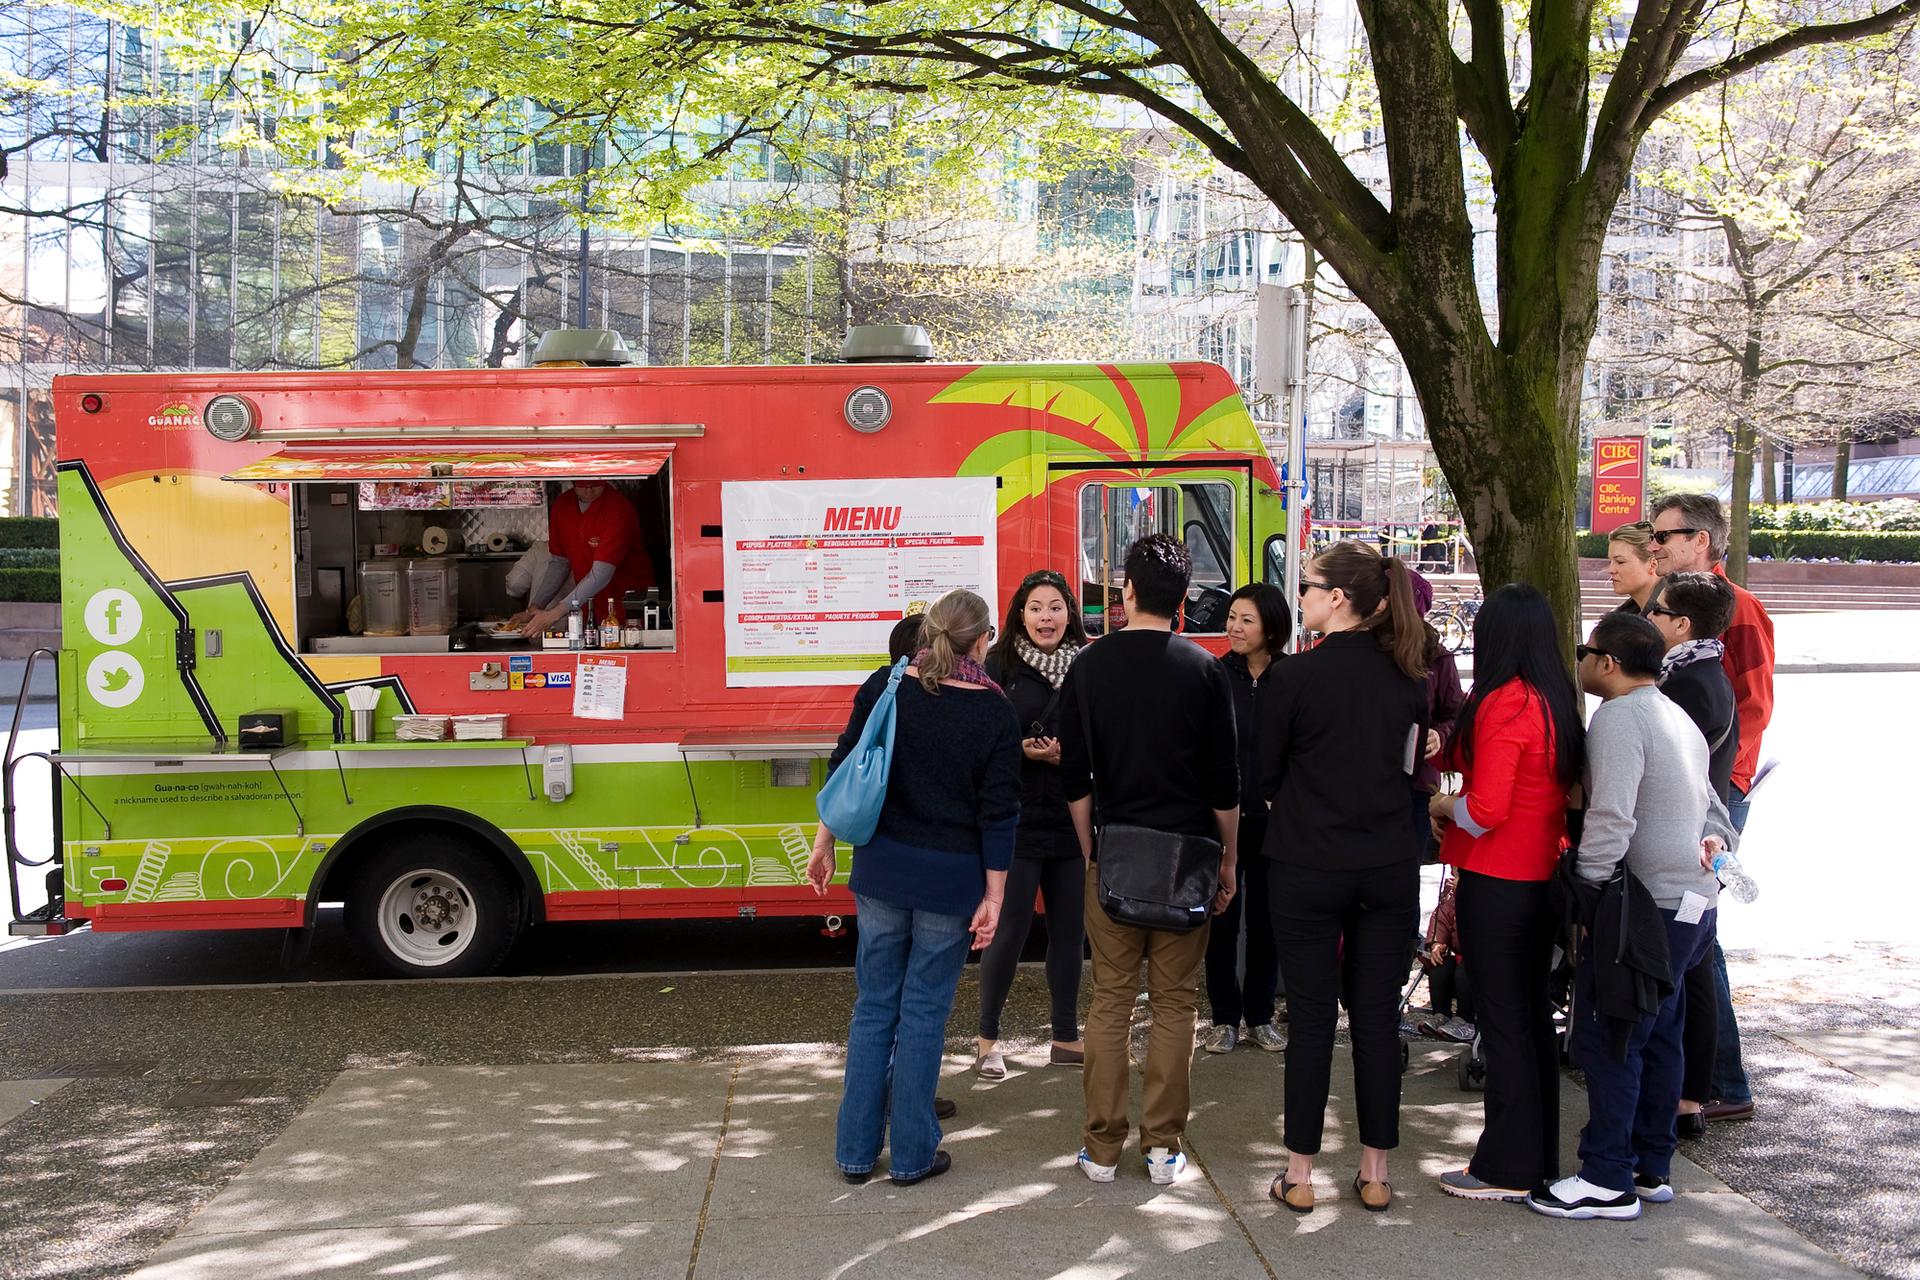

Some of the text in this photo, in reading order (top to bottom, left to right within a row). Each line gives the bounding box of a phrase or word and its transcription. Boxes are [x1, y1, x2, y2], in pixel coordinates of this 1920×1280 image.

[148, 415, 206, 426] GÜANAC
[1600, 445, 1637, 459] CIBC
[1599, 484, 1621, 493] CIBC
[1599, 494, 1636, 506] Banking
[1598, 504, 1630, 514] Centre
[823, 506, 902, 531] MENU
[742, 541, 766, 549] PUPUSA
[743, 613, 816, 621] COMPLEMENTOS/EXTRAS
[824, 611, 879, 620] PAQUETE PEQUEÑO
[551, 674, 570, 682] VISA
[154, 782, 262, 792] Gua-na-co [gwah-nah-koh]
[119, 796, 159, 805] nickname
[160, 795, 179, 804] used
[190, 794, 223, 803] describe
[230, 792, 272, 801] salvadoran
